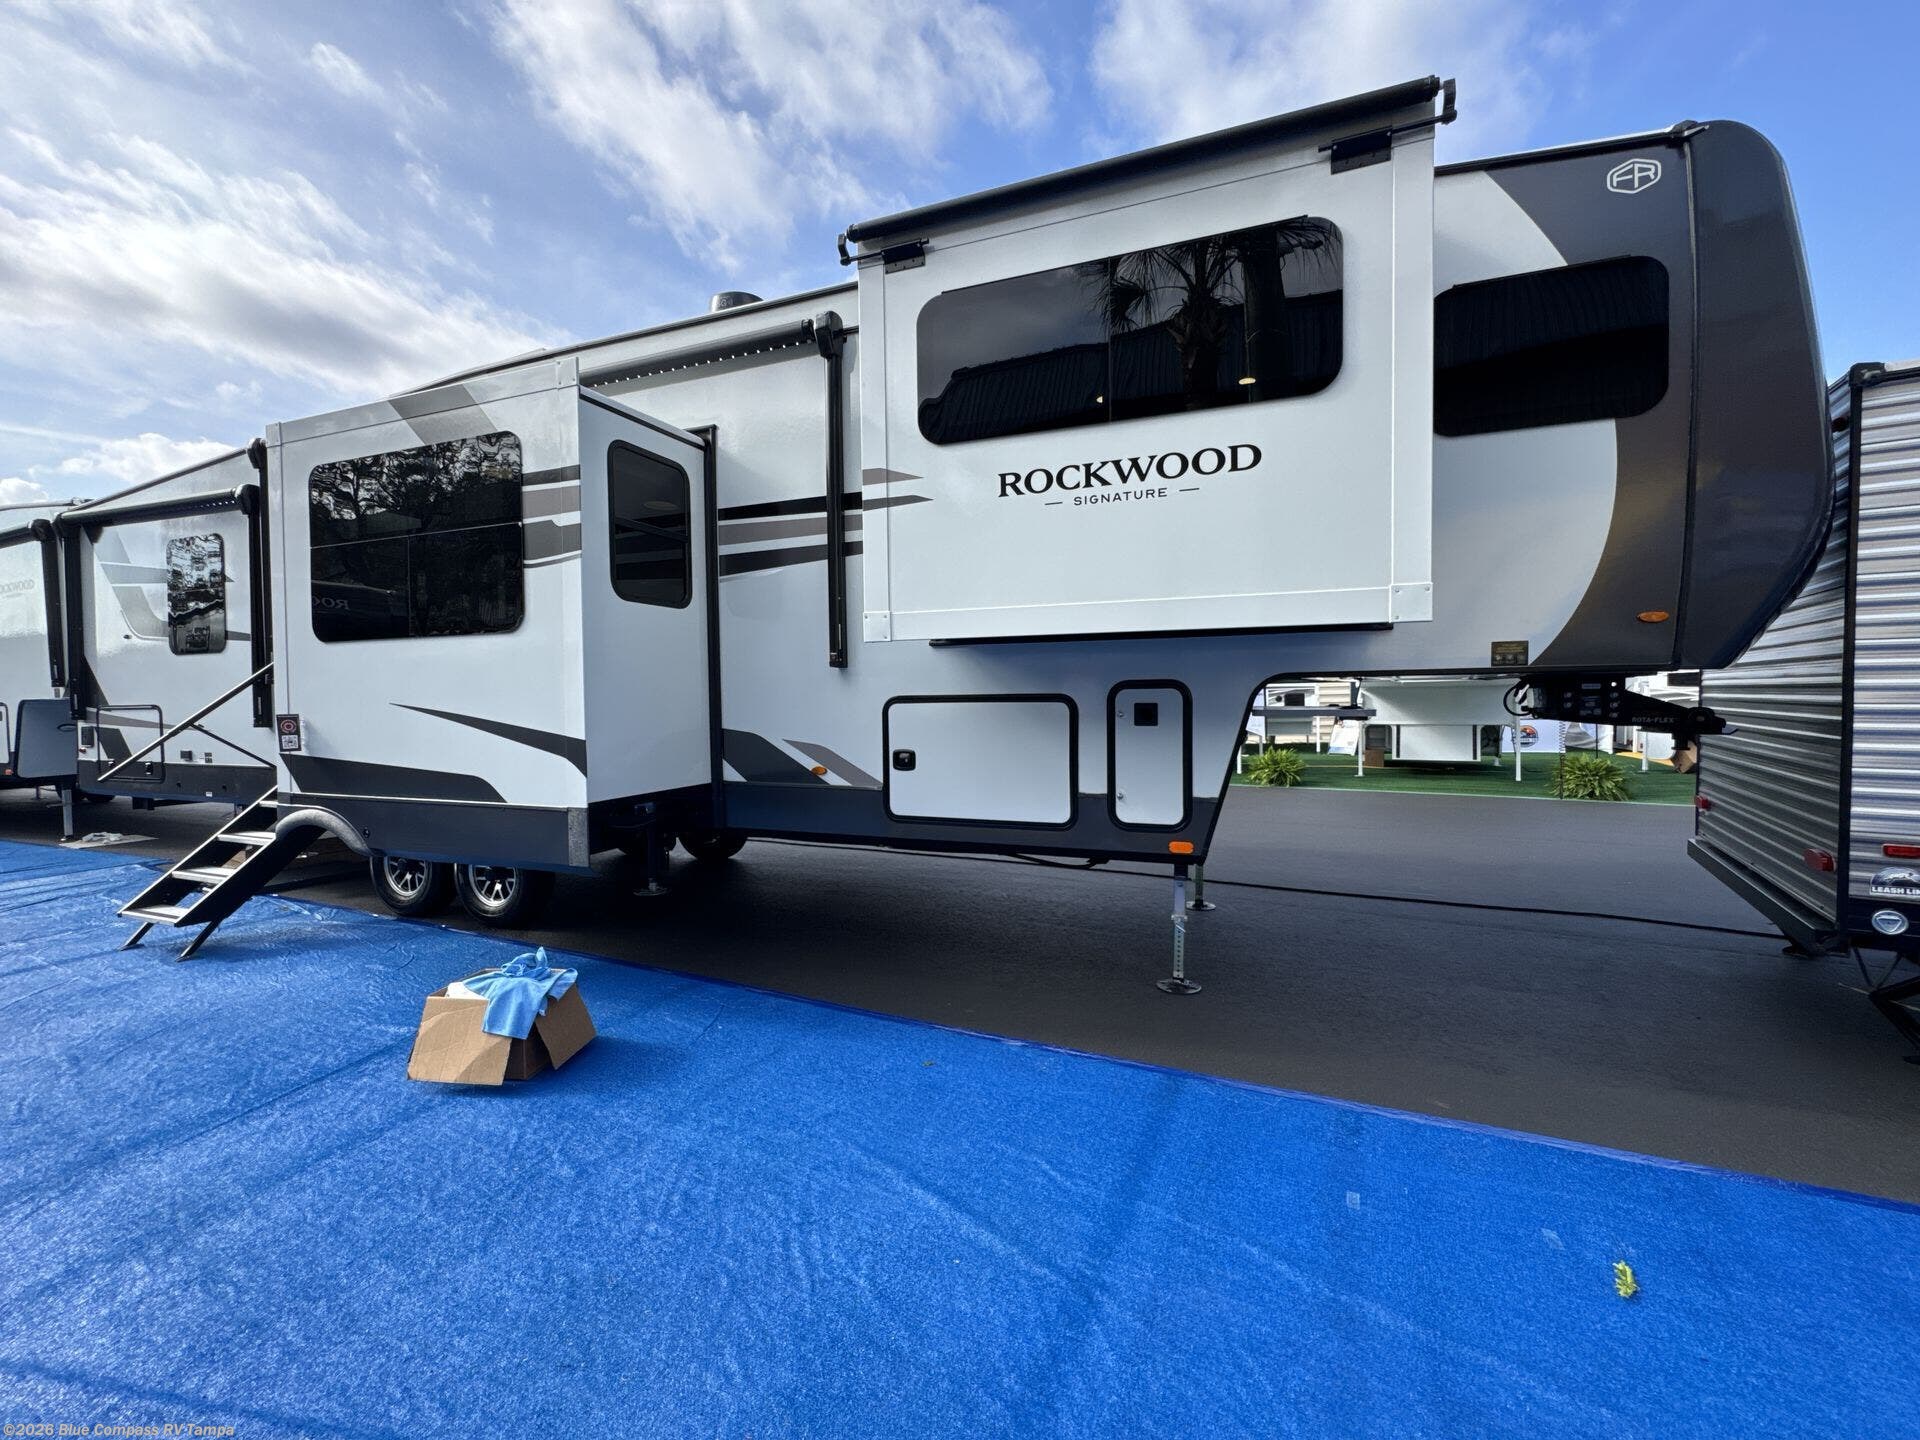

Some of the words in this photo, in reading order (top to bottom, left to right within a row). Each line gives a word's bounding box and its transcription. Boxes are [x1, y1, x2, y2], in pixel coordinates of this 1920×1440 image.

[998, 444, 1262, 498] ROCKWOOD
[1073, 487, 1168, 506] SIGNATURE
[1871, 886, 1905, 894] LEASH
